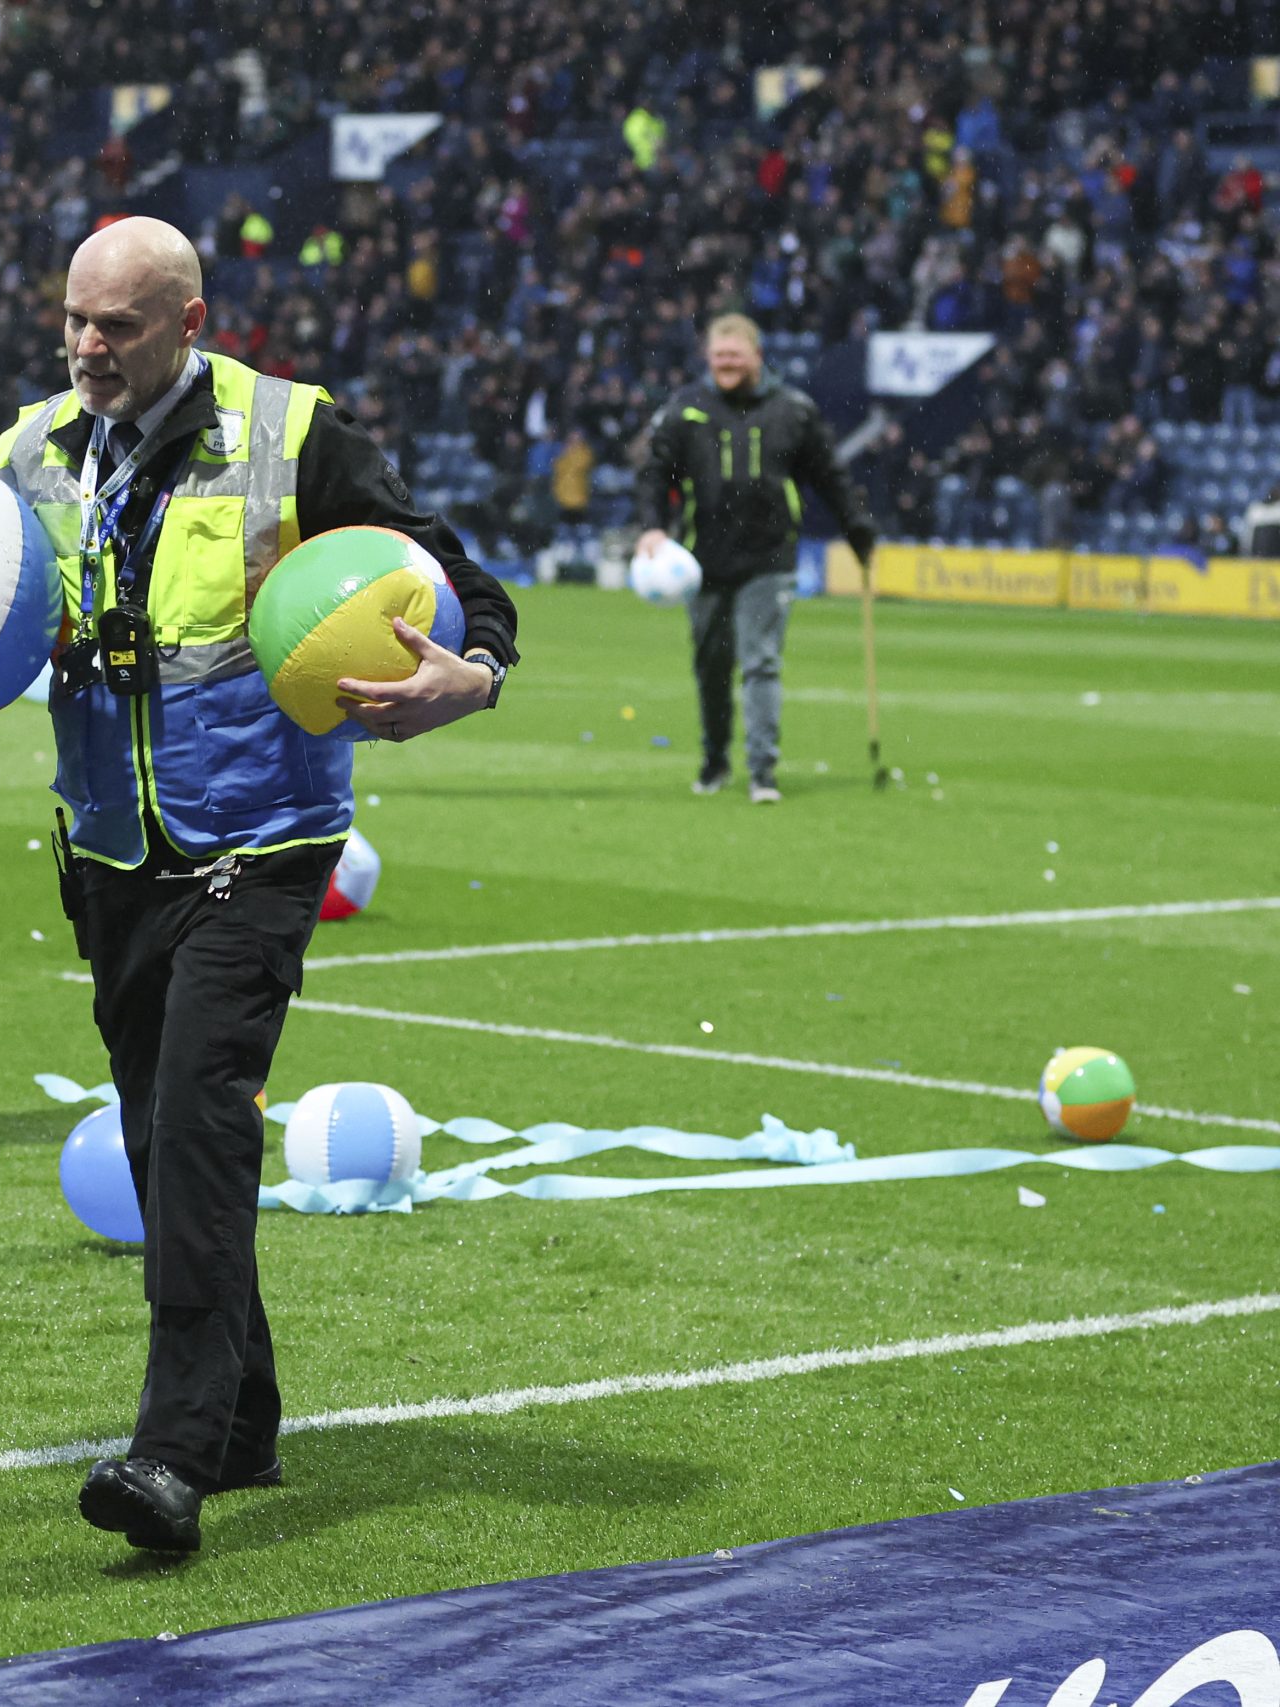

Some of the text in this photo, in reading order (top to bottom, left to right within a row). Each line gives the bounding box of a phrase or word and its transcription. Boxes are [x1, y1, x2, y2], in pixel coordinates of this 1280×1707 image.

[107, 464, 134, 492] SUNFLOWER
[110, 508, 119, 518] EFL
[100, 528, 109, 539] EFL
